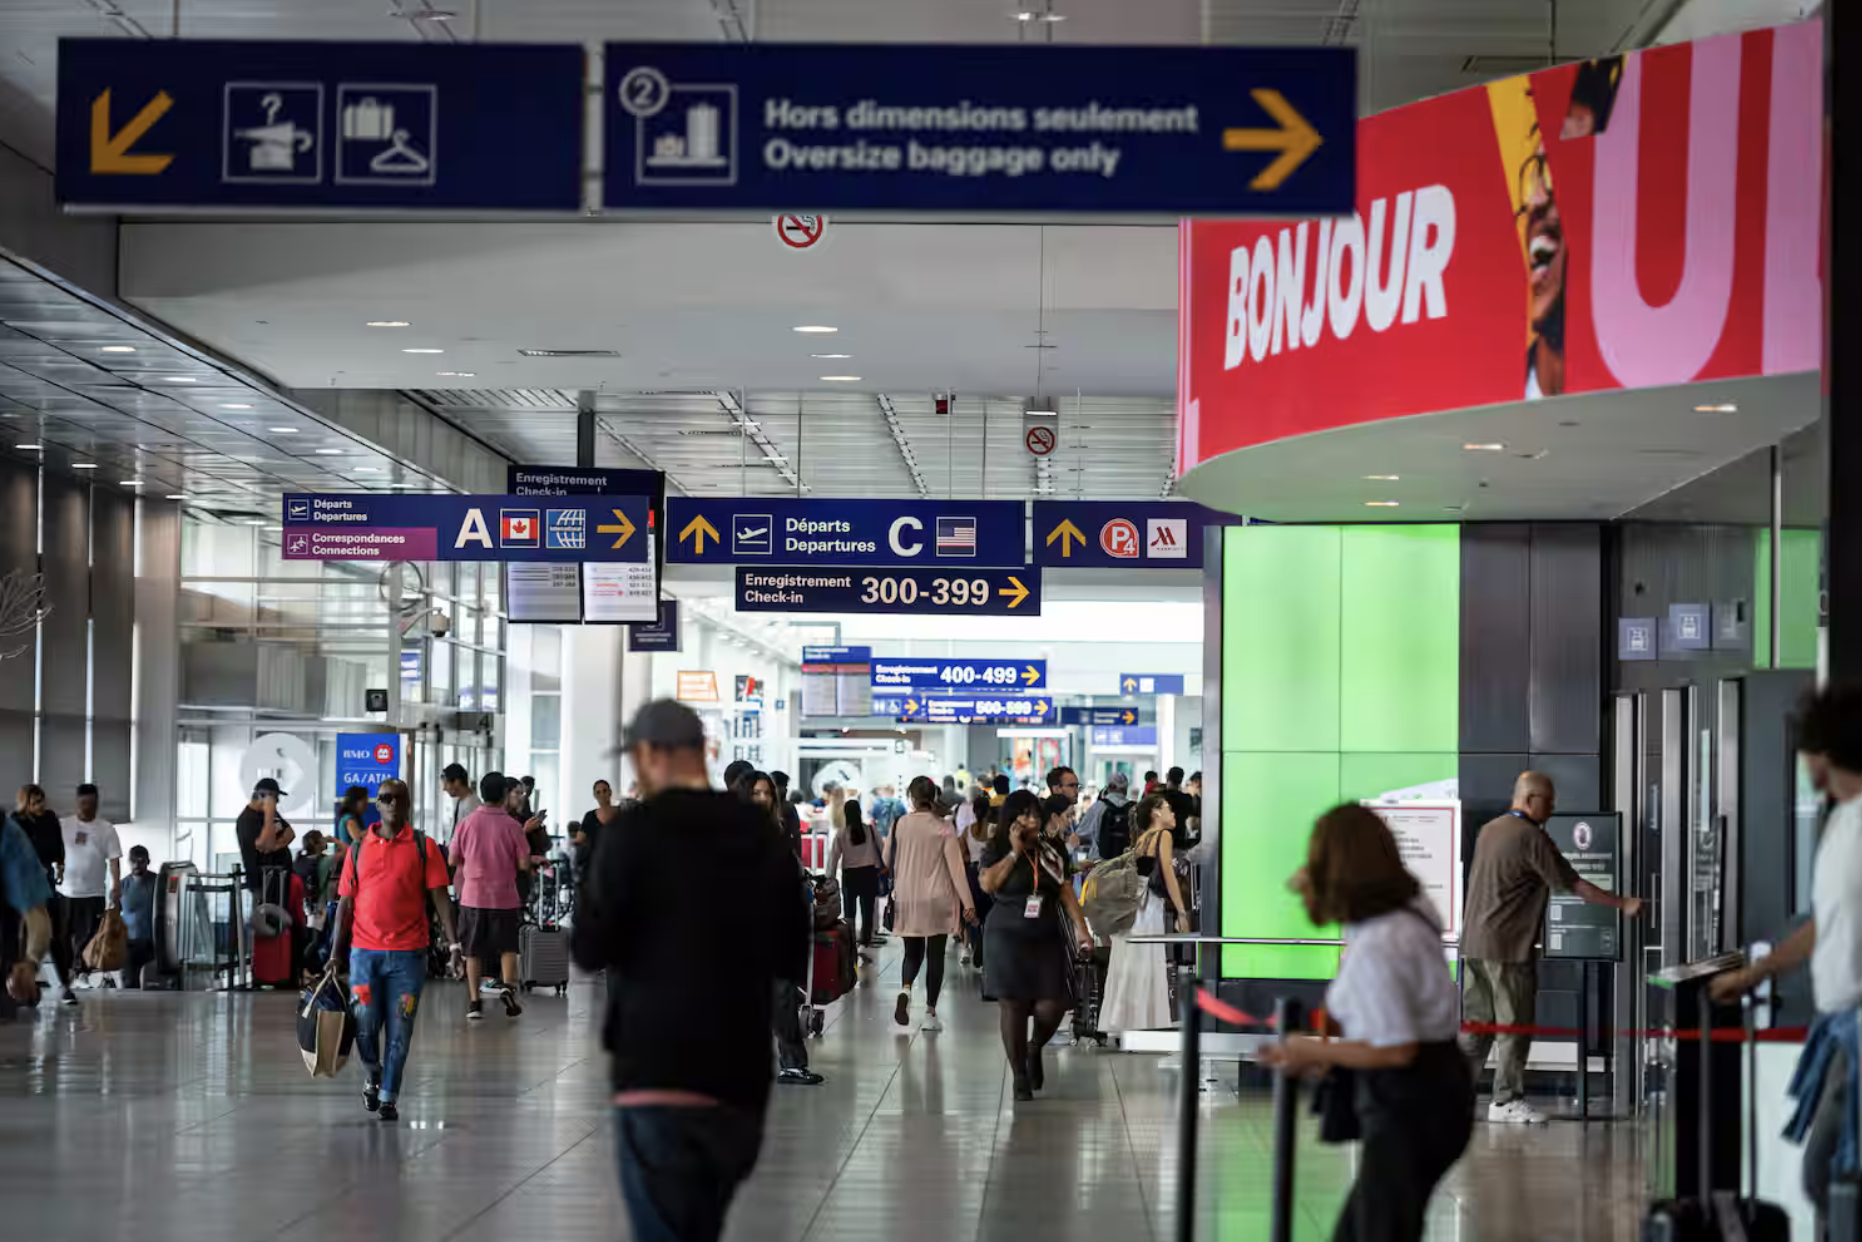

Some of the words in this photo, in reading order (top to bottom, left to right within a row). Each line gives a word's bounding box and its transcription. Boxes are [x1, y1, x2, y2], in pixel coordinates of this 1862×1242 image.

[632, 77, 656, 107] 2
[765, 99, 838, 130] Hors
[845, 101, 1027, 131] dimensions
[1033, 104, 1199, 132] seulement
[764, 138, 902, 168] Oversize
[907, 141, 1044, 176] baggage
[1050, 143, 1120, 177] only
[1224, 184, 1457, 371] BONJOUR
[515, 472, 608, 487] Enregistrement
[515, 485, 568, 496] Check-in
[313, 498, 353, 510] Départs
[313, 511, 368, 523] Departures
[785, 517, 851, 535] Départs
[454, 508, 494, 549] A
[888, 516, 924, 557] C
[312, 533, 406, 546] Correspondances
[785, 537, 876, 555] Departures
[312, 545, 380, 557] Connections
[745, 573, 852, 591] Enregistrement
[744, 590, 804, 604] Check-in
[860, 577, 990, 606] 300-399
[939, 666, 1017, 684] 400-499
[343, 749, 370, 759] BMO
